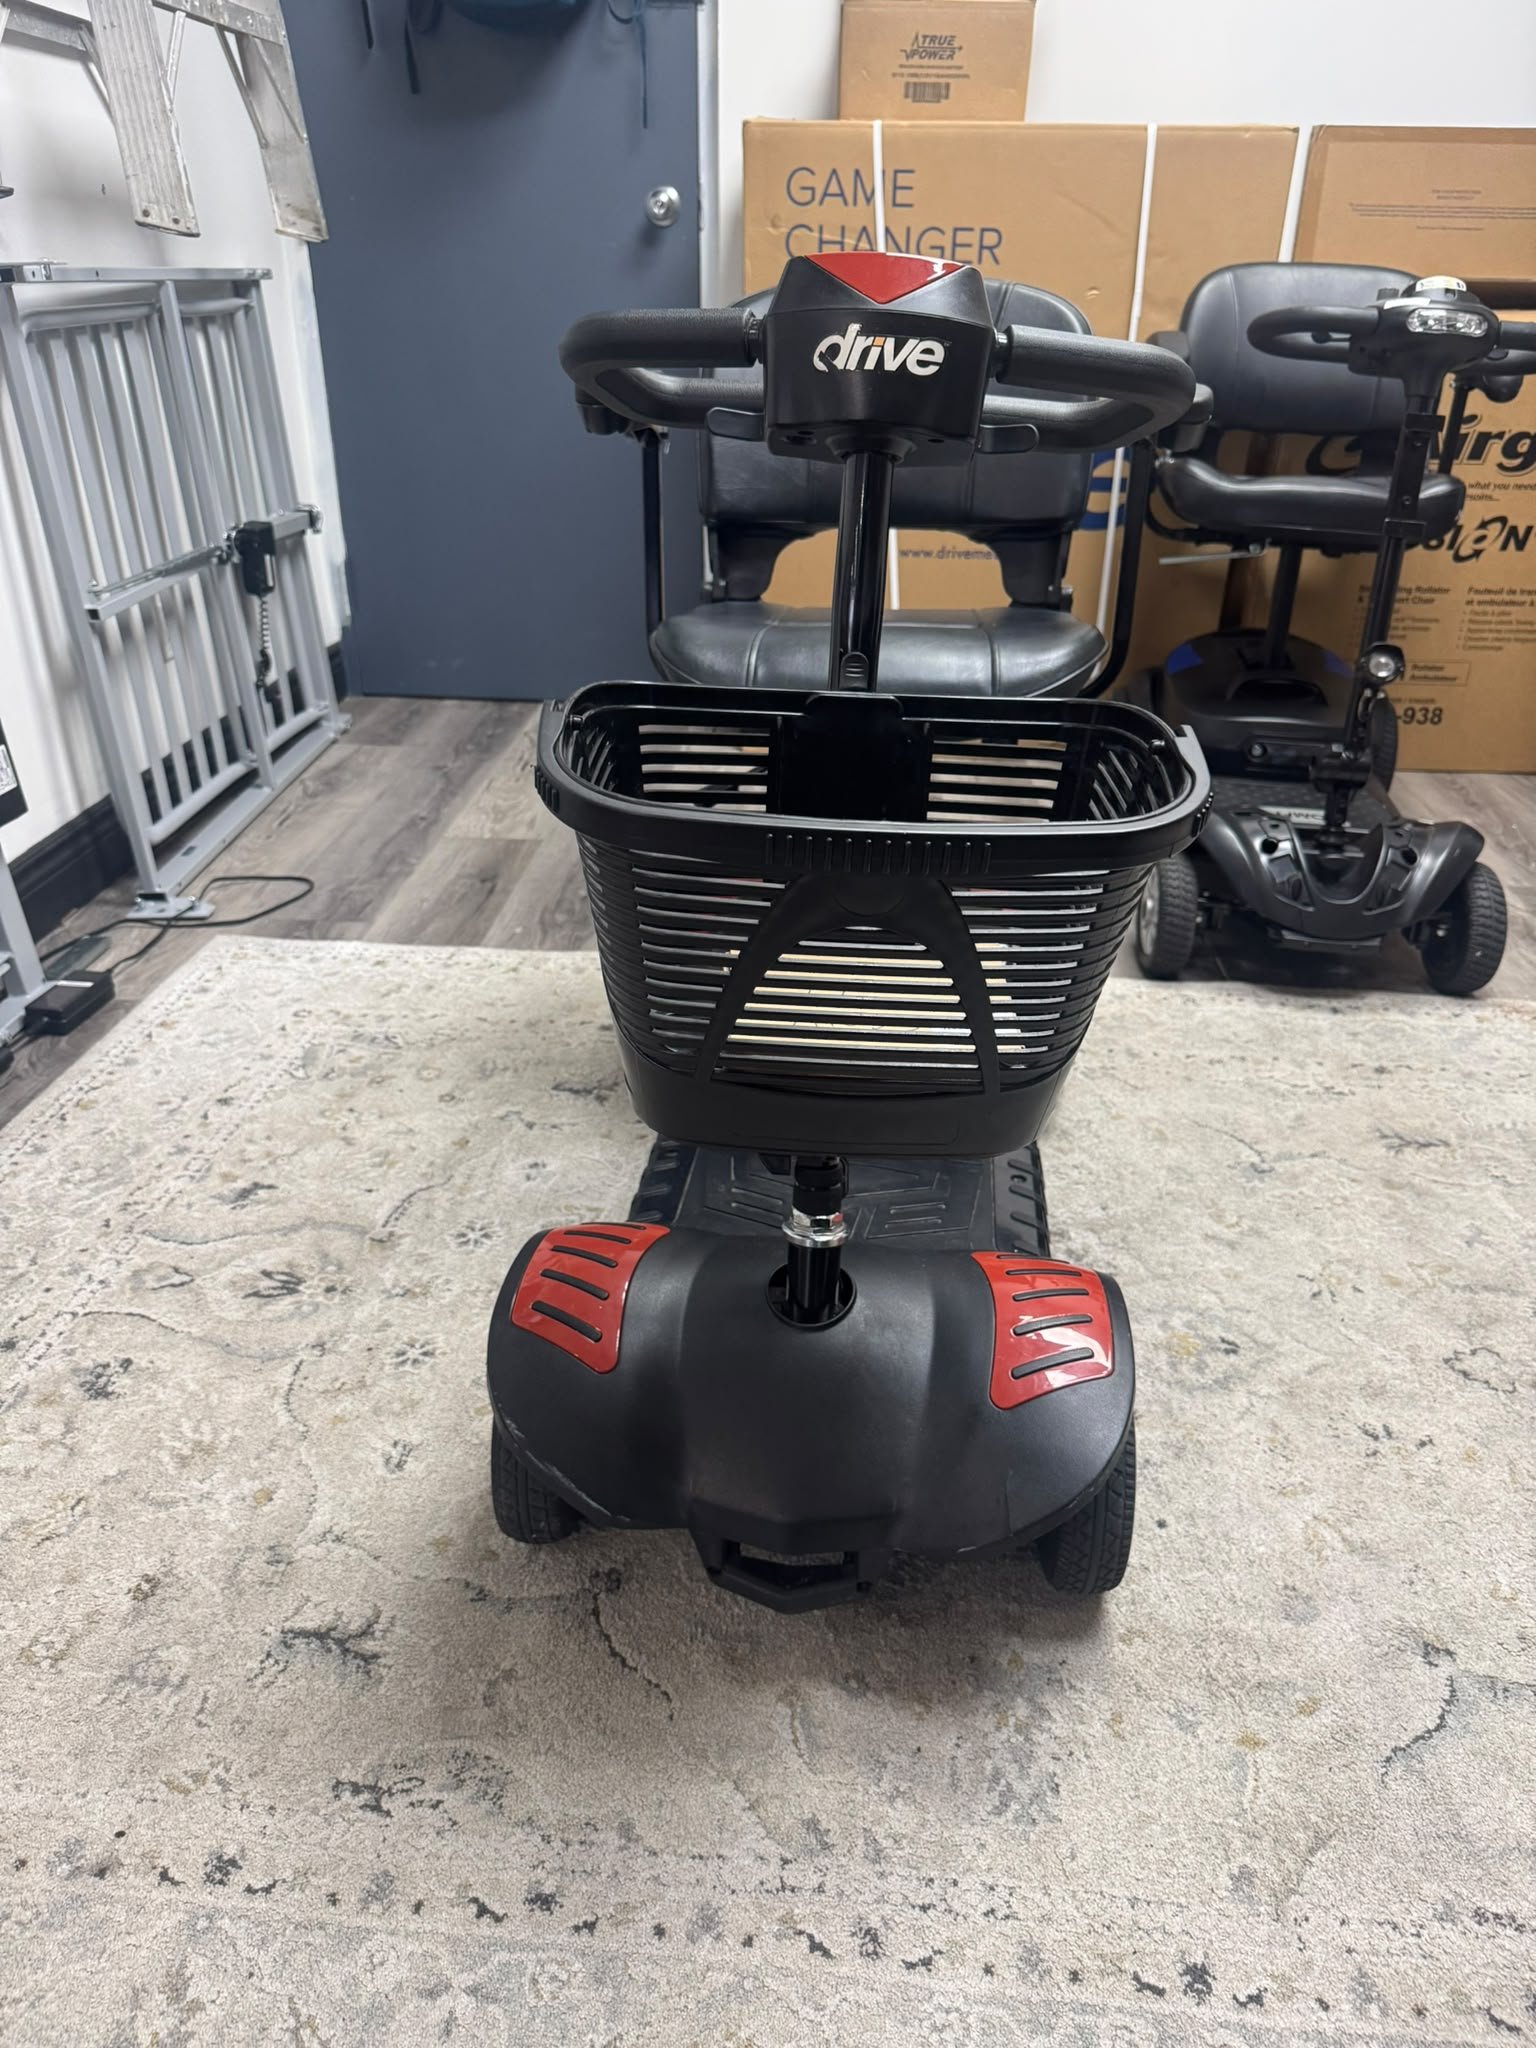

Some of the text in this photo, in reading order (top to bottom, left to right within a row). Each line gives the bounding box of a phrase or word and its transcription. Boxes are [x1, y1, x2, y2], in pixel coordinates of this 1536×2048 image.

[910, 49, 956, 60] POWER
[921, 34, 956, 46] TRUE
[786, 167, 915, 208] GAME
[785, 224, 1003, 266] CHANGER
[813, 322, 946, 376] drive
[1448, 413, 1536, 477] irg
[899, 544, 998, 560] www.driveme
[1397, 706, 1443, 725] -938
